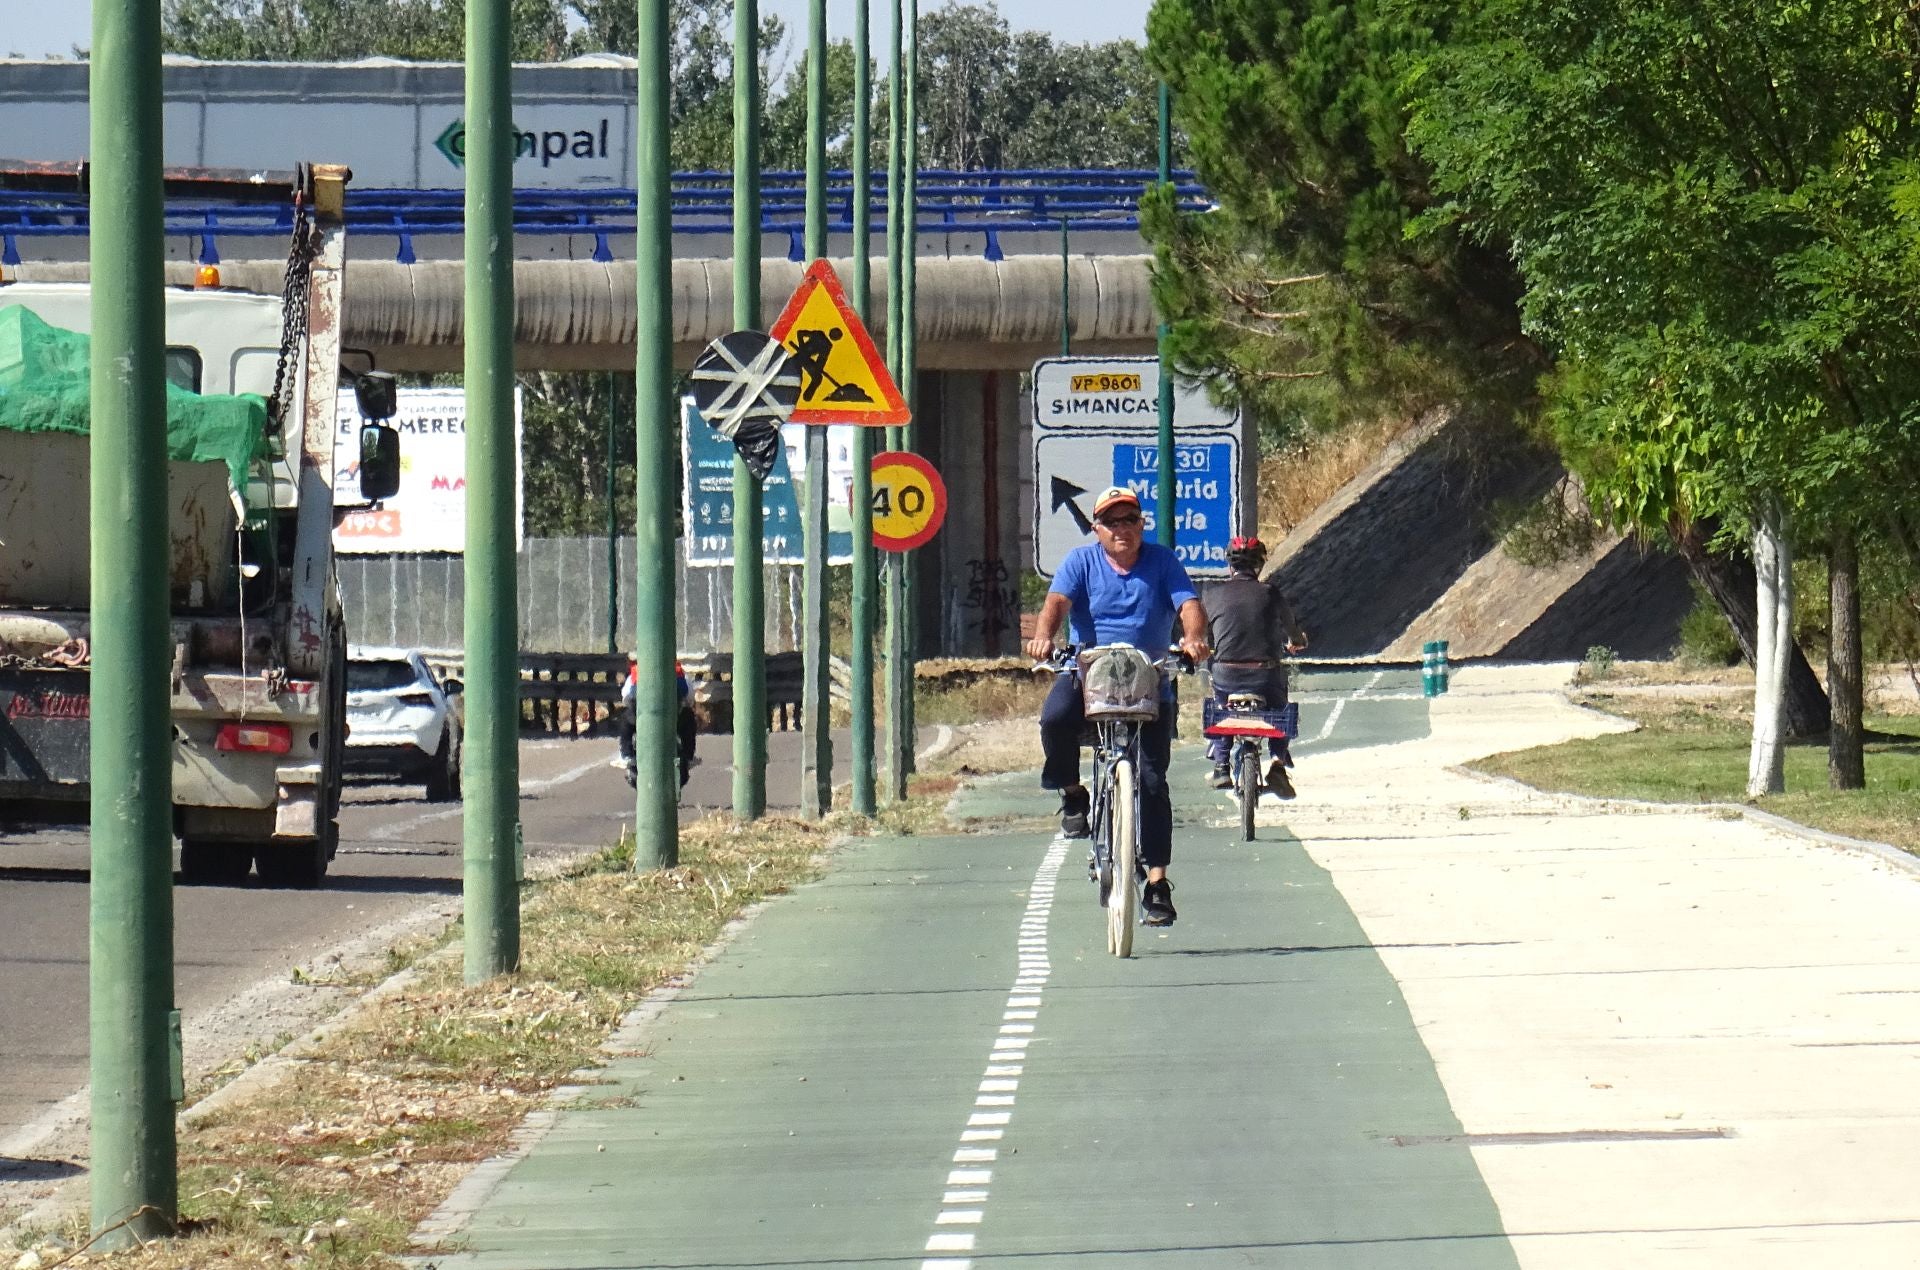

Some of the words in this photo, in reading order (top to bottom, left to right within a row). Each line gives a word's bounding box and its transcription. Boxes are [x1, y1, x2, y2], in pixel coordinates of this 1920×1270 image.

[1140, 450, 1205, 468] V30
[873, 485, 925, 518] 40
[1141, 507, 1208, 531] Sria
